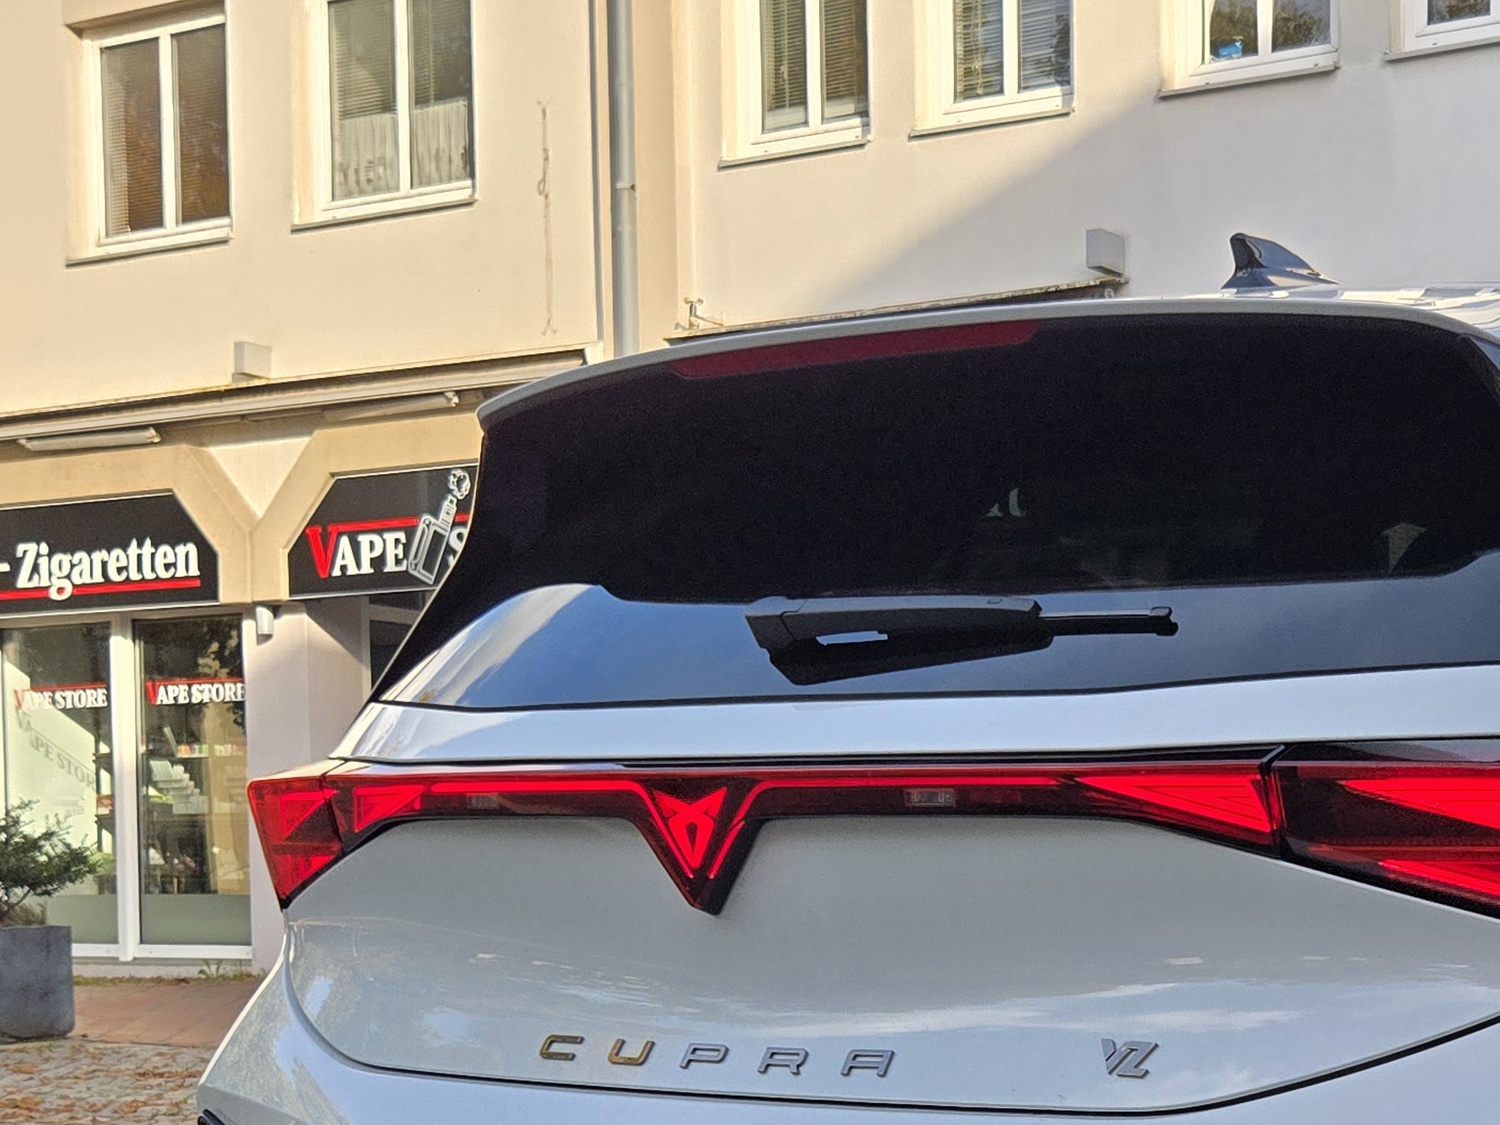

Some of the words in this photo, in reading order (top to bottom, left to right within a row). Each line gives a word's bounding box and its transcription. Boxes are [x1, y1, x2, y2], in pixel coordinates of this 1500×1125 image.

[306, 524, 408, 579] VAPE
[14, 689, 53, 710] VAPE
[54, 687, 108, 710] STORE
[146, 681, 189, 704] VAPE
[539, 1033, 895, 1078] CUPRA
[1101, 1038, 1159, 1079] VZ
